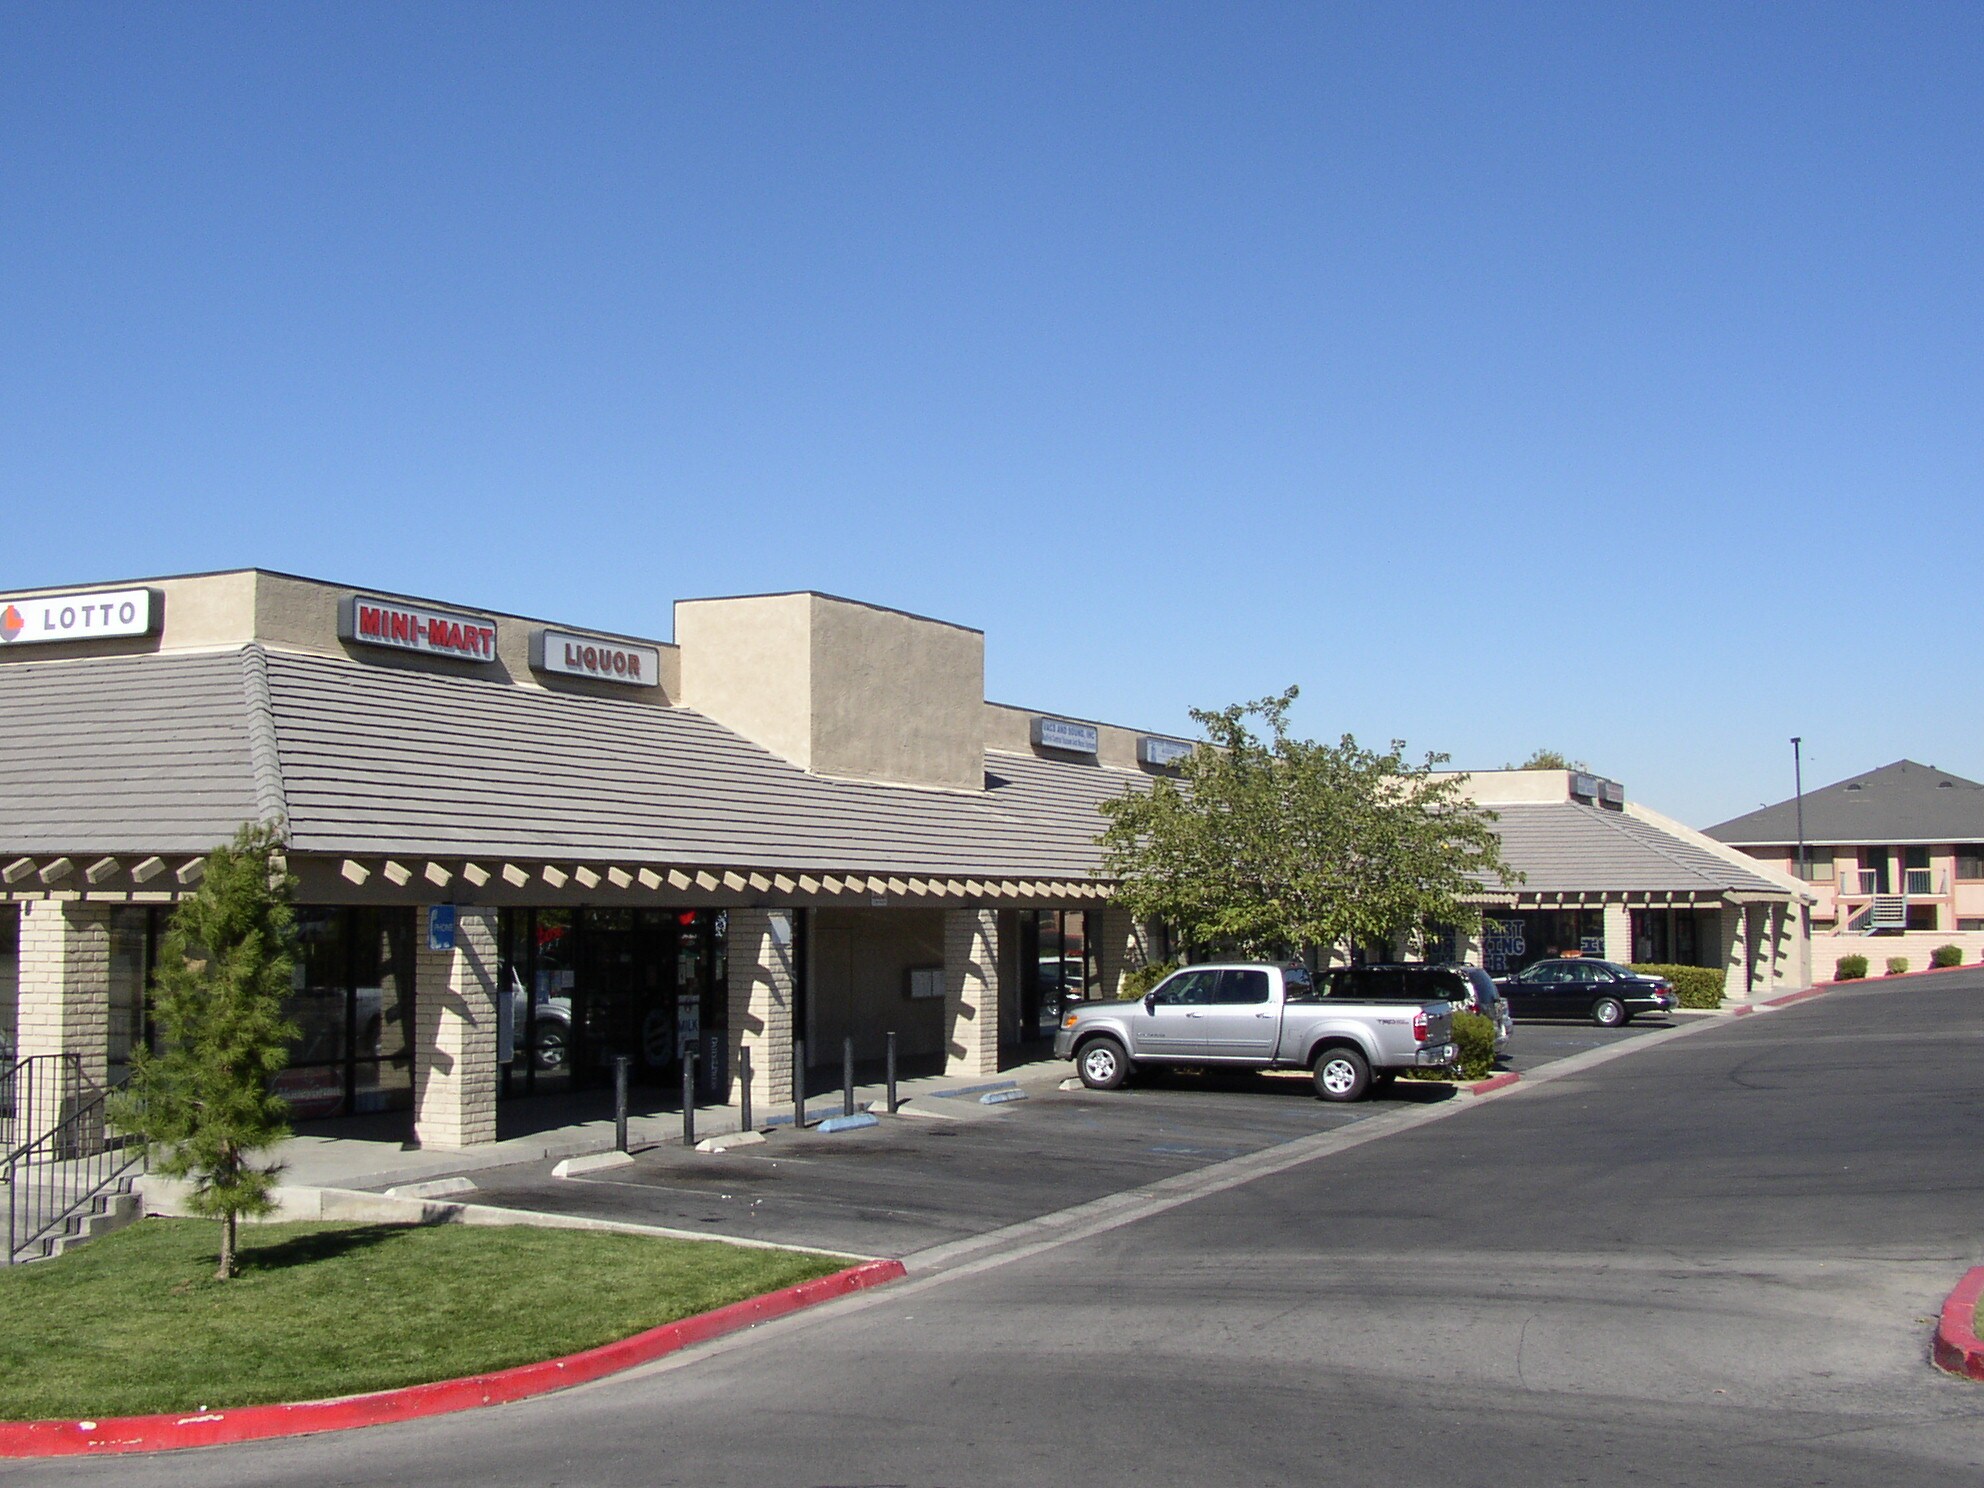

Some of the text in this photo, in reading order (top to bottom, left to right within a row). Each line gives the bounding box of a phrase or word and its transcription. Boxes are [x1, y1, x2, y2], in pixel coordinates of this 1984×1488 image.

[44, 601, 136, 631] LOTTO
[359, 605, 494, 656] MINI-MART
[564, 642, 641, 677] LIQUOR
[433, 923, 454, 932] PHONE
